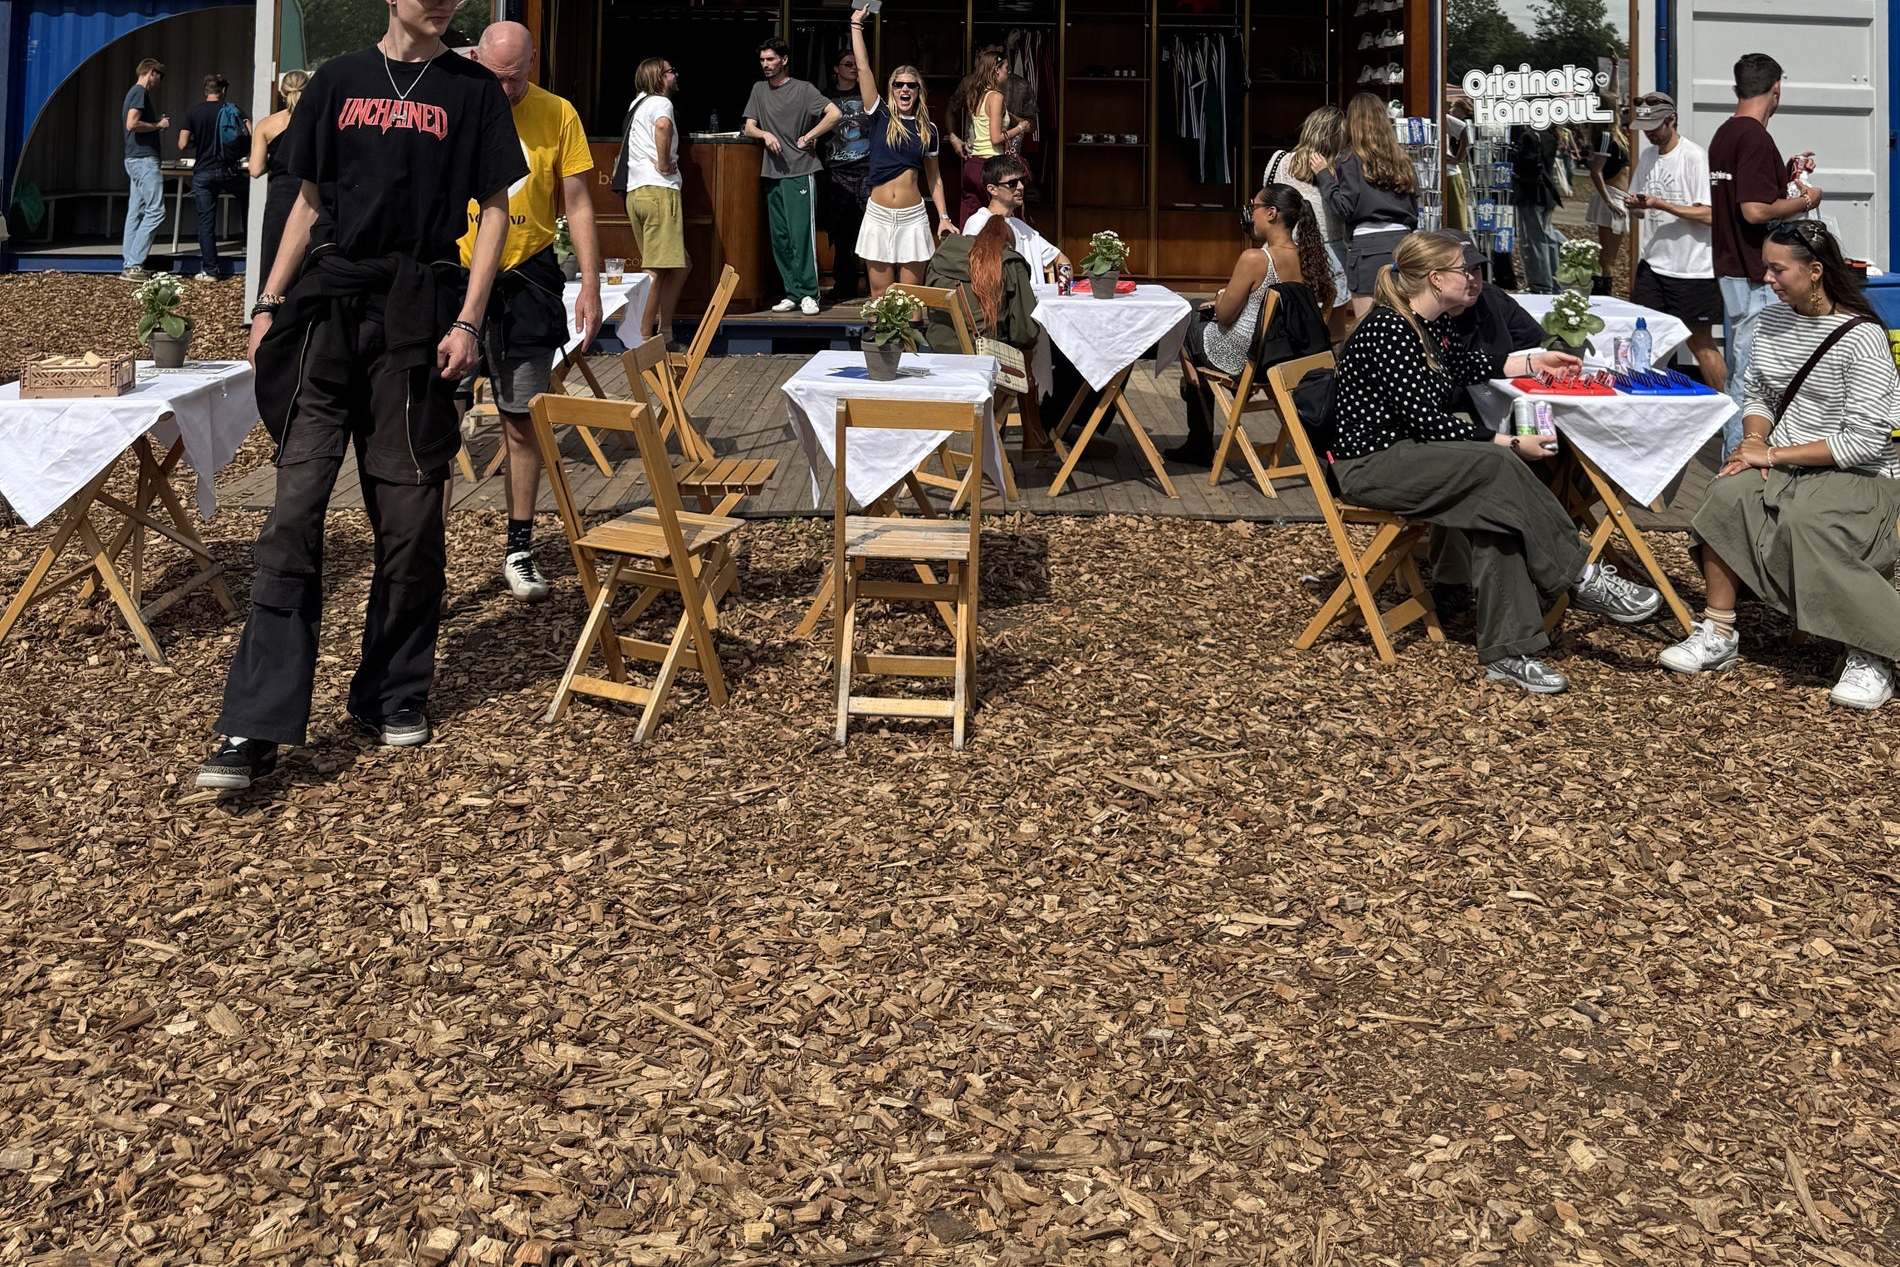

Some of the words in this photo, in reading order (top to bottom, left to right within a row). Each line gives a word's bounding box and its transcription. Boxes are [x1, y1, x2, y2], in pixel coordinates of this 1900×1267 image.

[1462, 63, 1594, 100] Originals
[337, 97, 449, 141] UNCHAINED
[1474, 92, 1614, 131] Hangout
